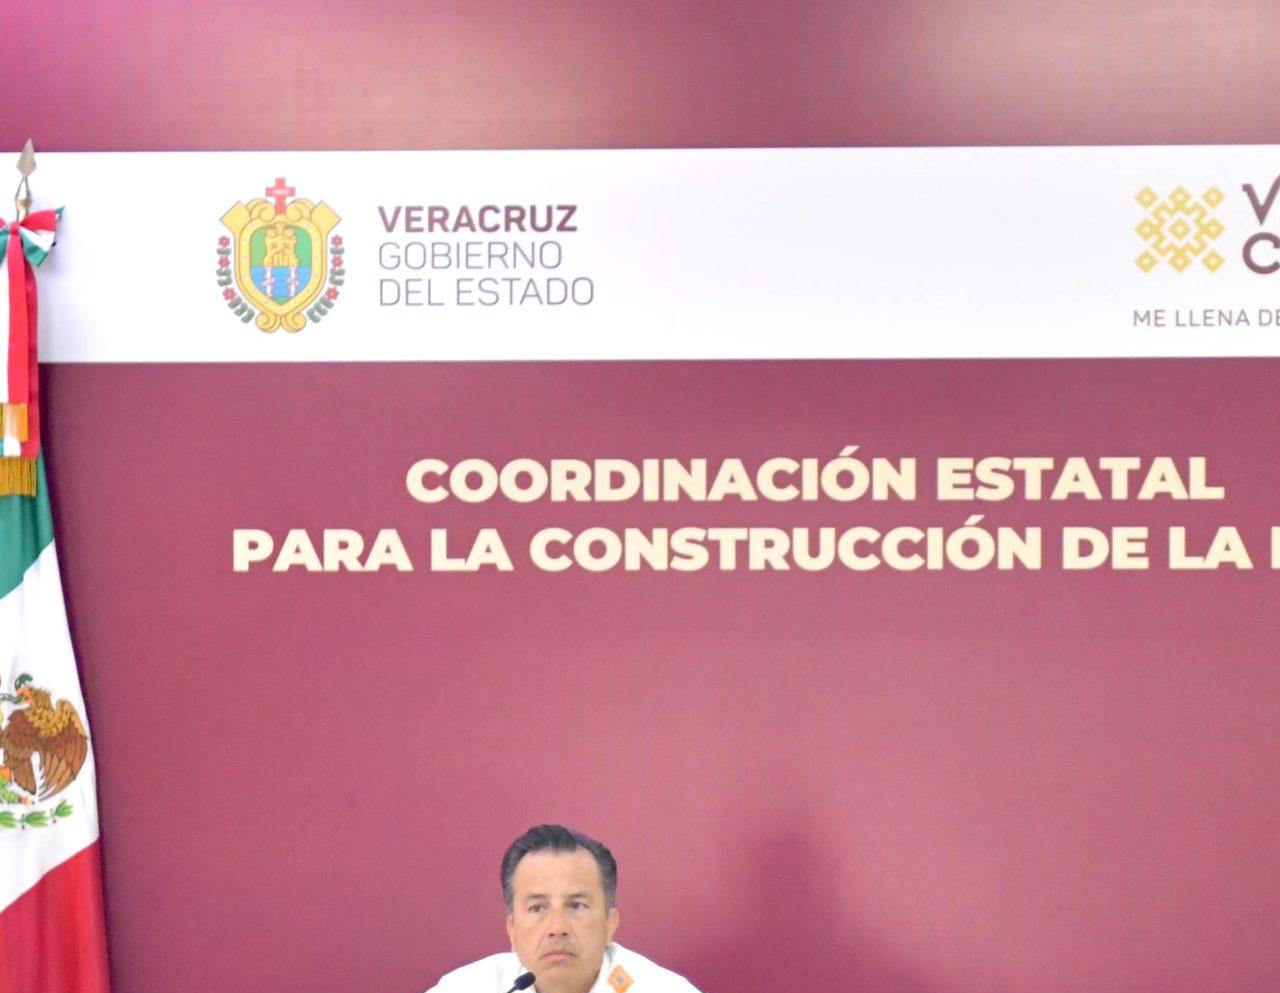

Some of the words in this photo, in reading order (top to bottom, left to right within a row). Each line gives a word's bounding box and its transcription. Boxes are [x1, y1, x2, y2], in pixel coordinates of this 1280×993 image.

[377, 204, 578, 233] VERACRUZ
[378, 240, 563, 270] GOBIERNO
[379, 278, 444, 306] DEL
[456, 276, 595, 306] ESTADO
[1133, 309, 1166, 327] ME
[1175, 308, 1250, 327] LLENA
[405, 445, 917, 503] COORDINACIÓN
[936, 456, 1226, 502] ESTATAL
[232, 528, 414, 572] PARA
[430, 528, 515, 571] LA
[529, 514, 1042, 572] CONSTRUCCIÓN
[1062, 526, 1150, 571] DE
[1168, 526, 1254, 570] LA
